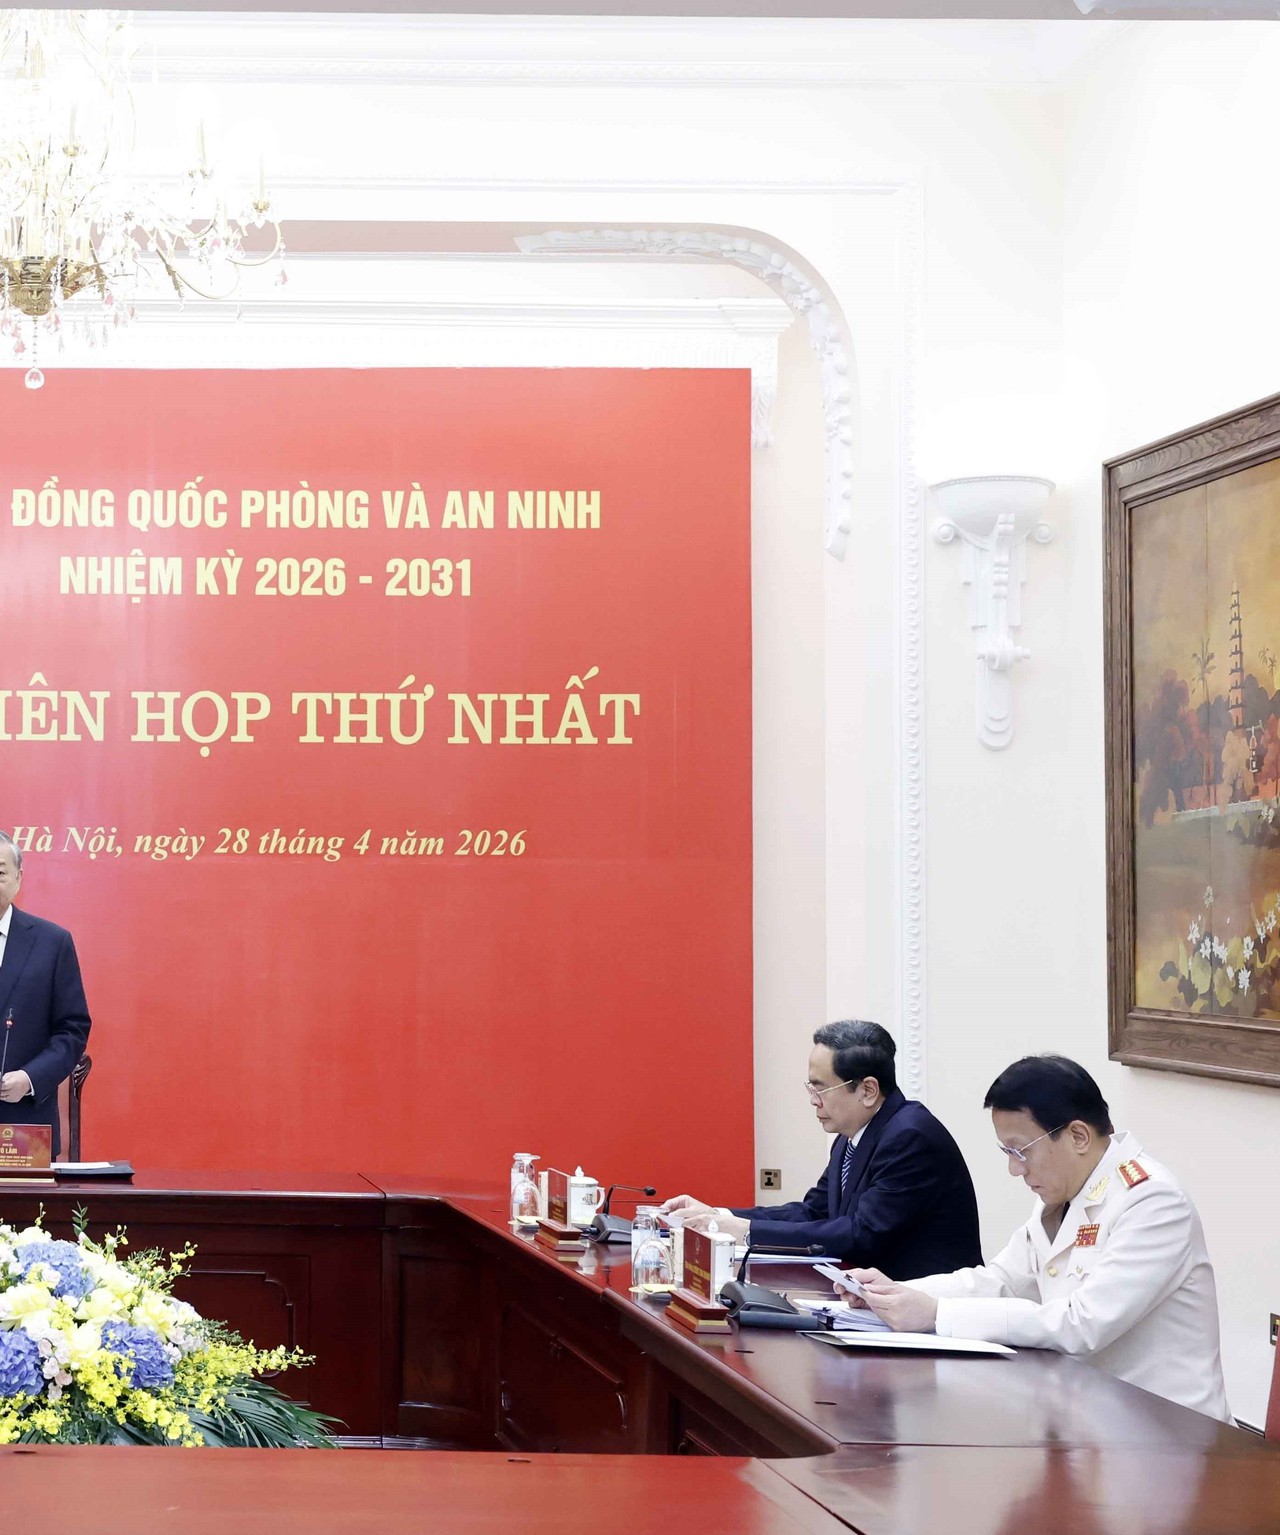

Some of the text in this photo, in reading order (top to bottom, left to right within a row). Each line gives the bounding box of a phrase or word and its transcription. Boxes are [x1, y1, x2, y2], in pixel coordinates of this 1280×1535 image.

[10, 475, 115, 528] ĐỒNG
[127, 475, 228, 532] QUỐC
[240, 480, 370, 529] PHÒNG
[381, 481, 431, 529] VÀ
[441, 490, 495, 529] AN
[507, 490, 601, 529] NINH
[60, 548, 471, 604] NHIỆM KỲ 2026 - 2031
[130, 690, 271, 758] HỌP
[291, 674, 435, 746] THỨ
[447, 665, 641, 746] NHẤT
[12, 825, 528, 863] Hà Nội, ngày 28 tháng 4 năm 2026
